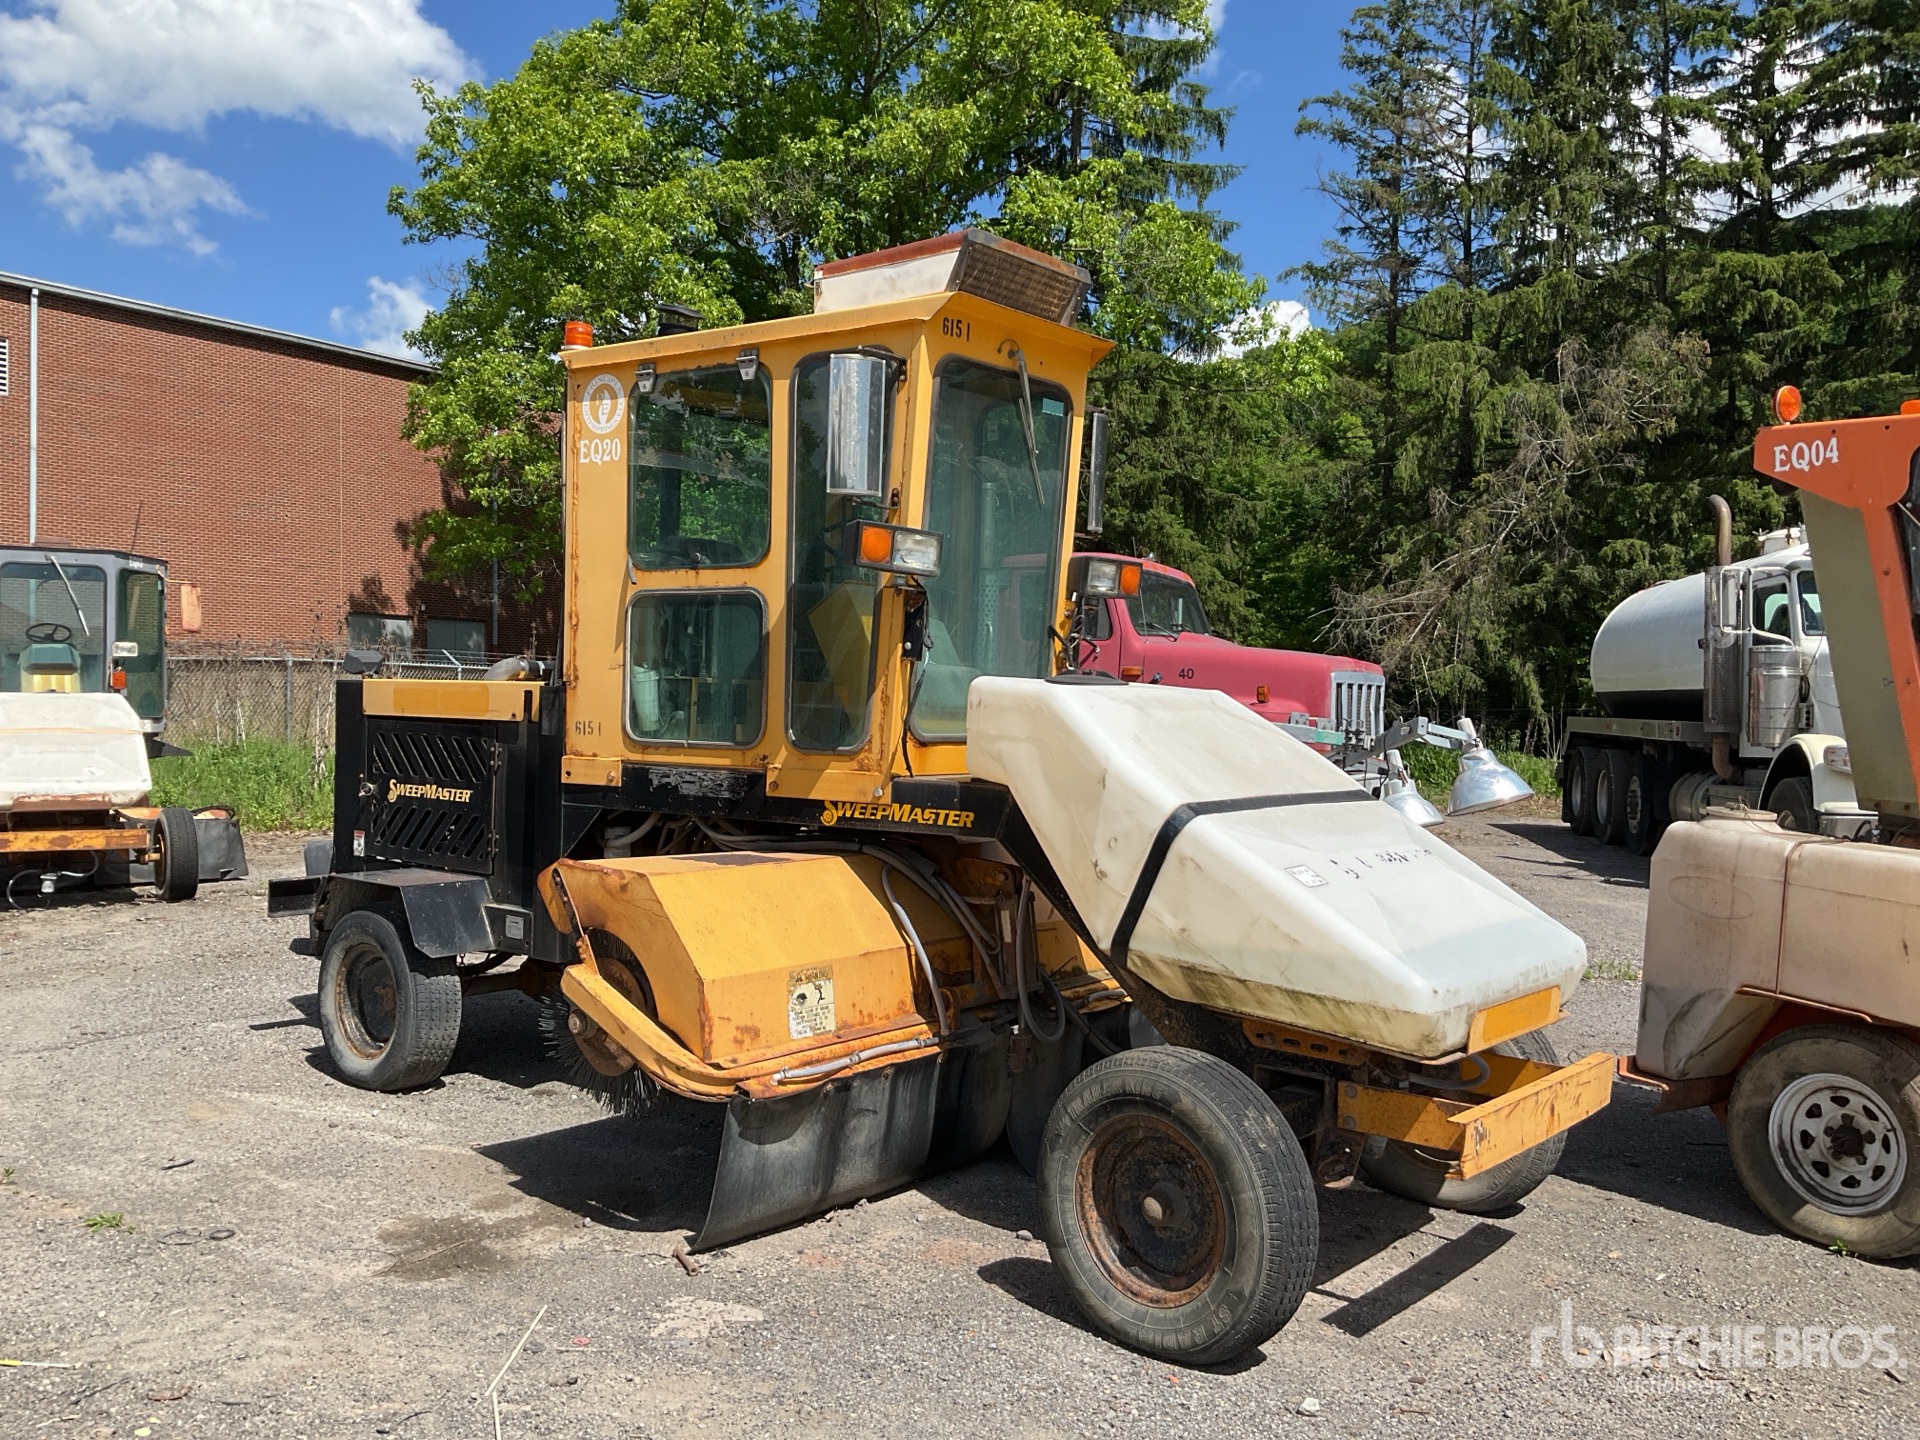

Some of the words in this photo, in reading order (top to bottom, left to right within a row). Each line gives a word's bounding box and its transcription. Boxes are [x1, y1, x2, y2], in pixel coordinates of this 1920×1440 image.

[579, 438, 621, 465] EQ20
[1773, 437, 1839, 472] EQ04
[1178, 668, 1195, 680] 40
[1210, 1304, 1232, 1335] ST
[1127, 1324, 1209, 1350] RADIAL
